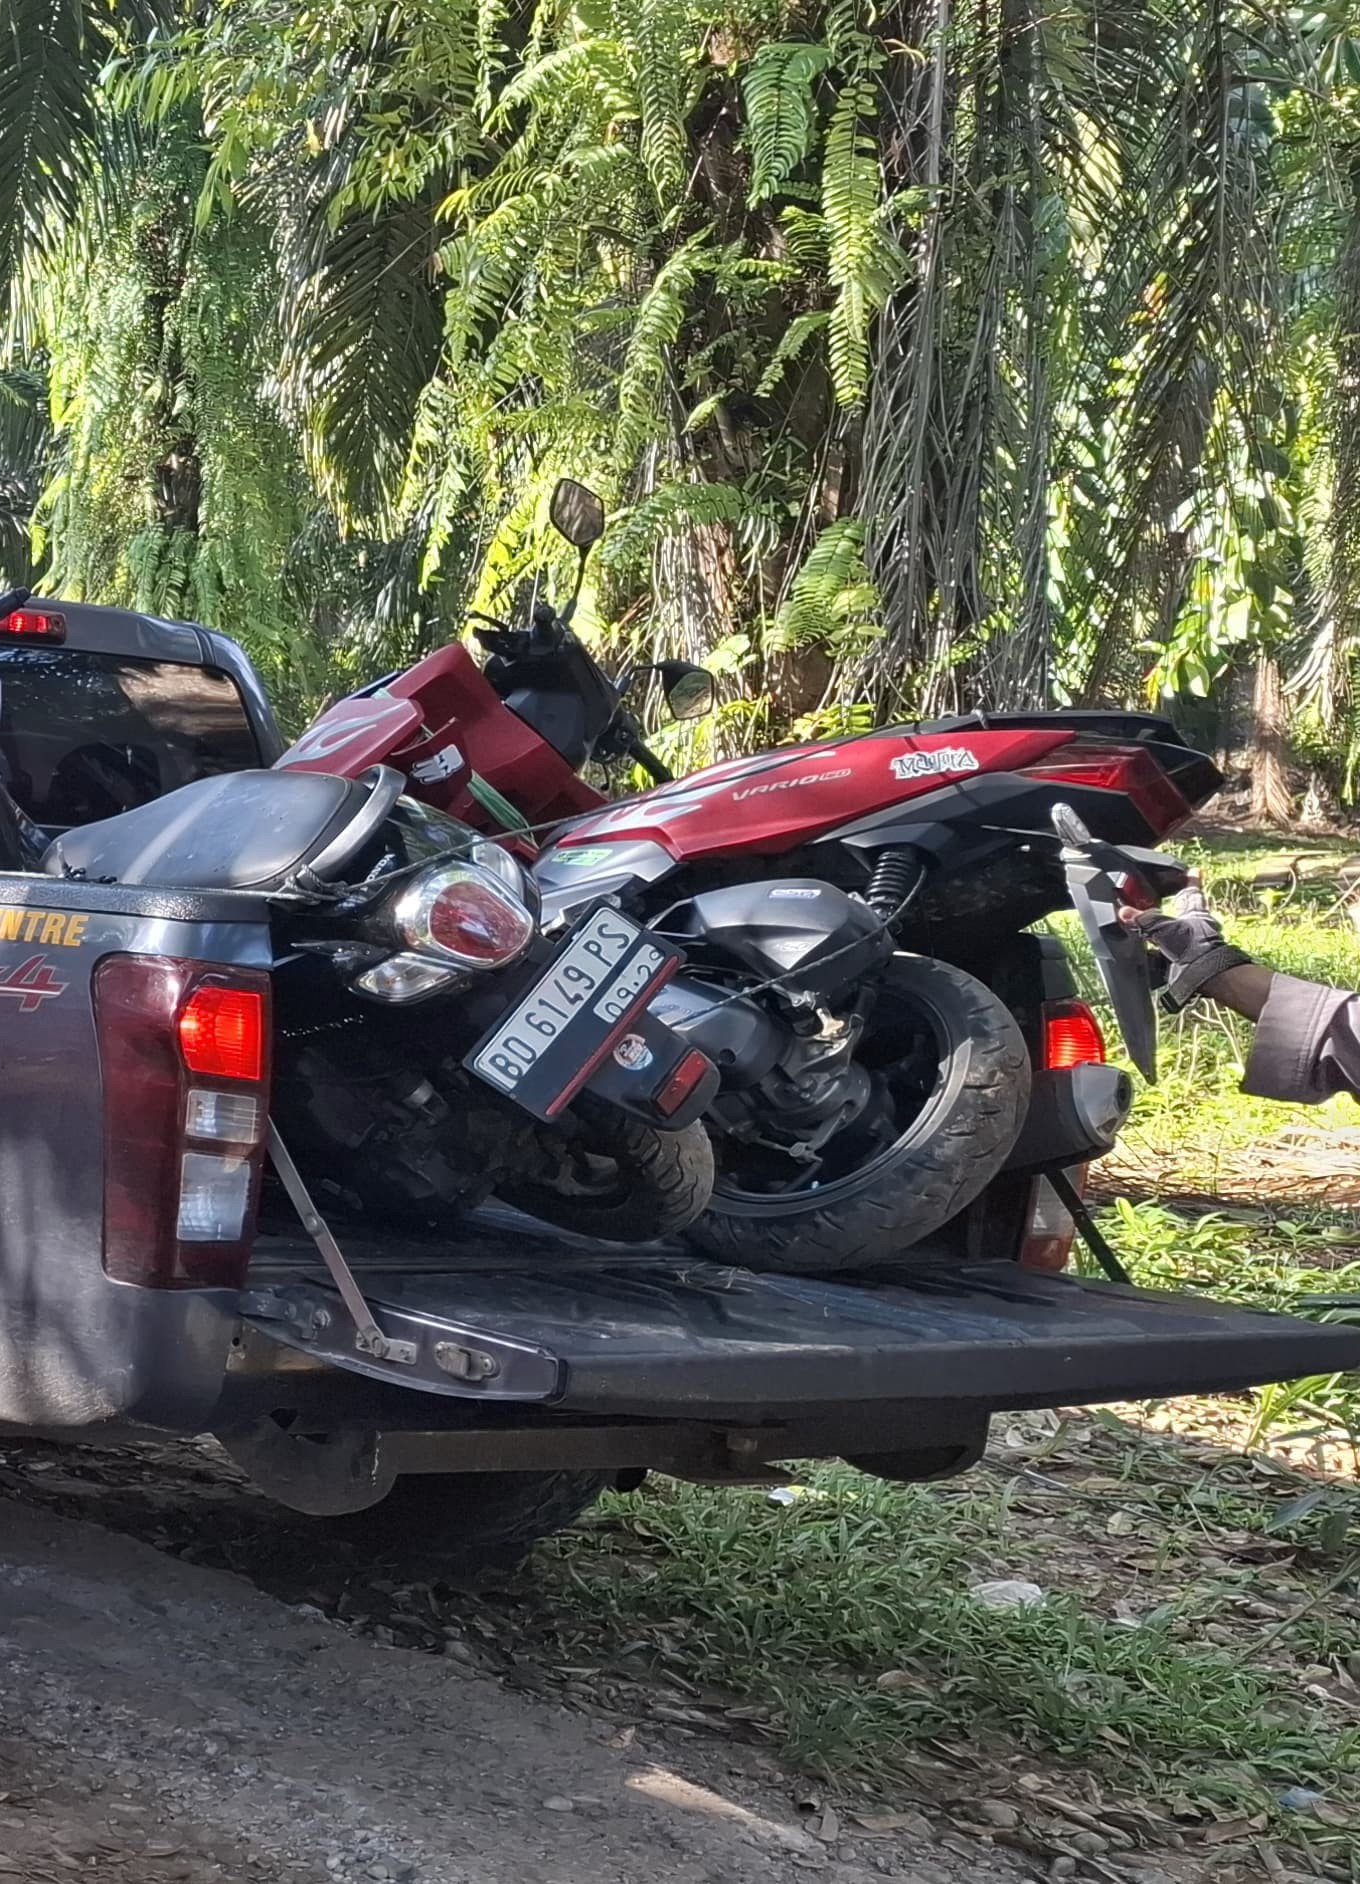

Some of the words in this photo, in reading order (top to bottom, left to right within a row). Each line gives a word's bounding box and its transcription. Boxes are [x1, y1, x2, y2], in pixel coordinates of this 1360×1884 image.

[732, 775, 819, 801] VARIO
[365, 853, 396, 881] ONDA
[487, 1036, 537, 1082] BD
[524, 965, 596, 1038] 6149
[582, 922, 630, 967] PS
